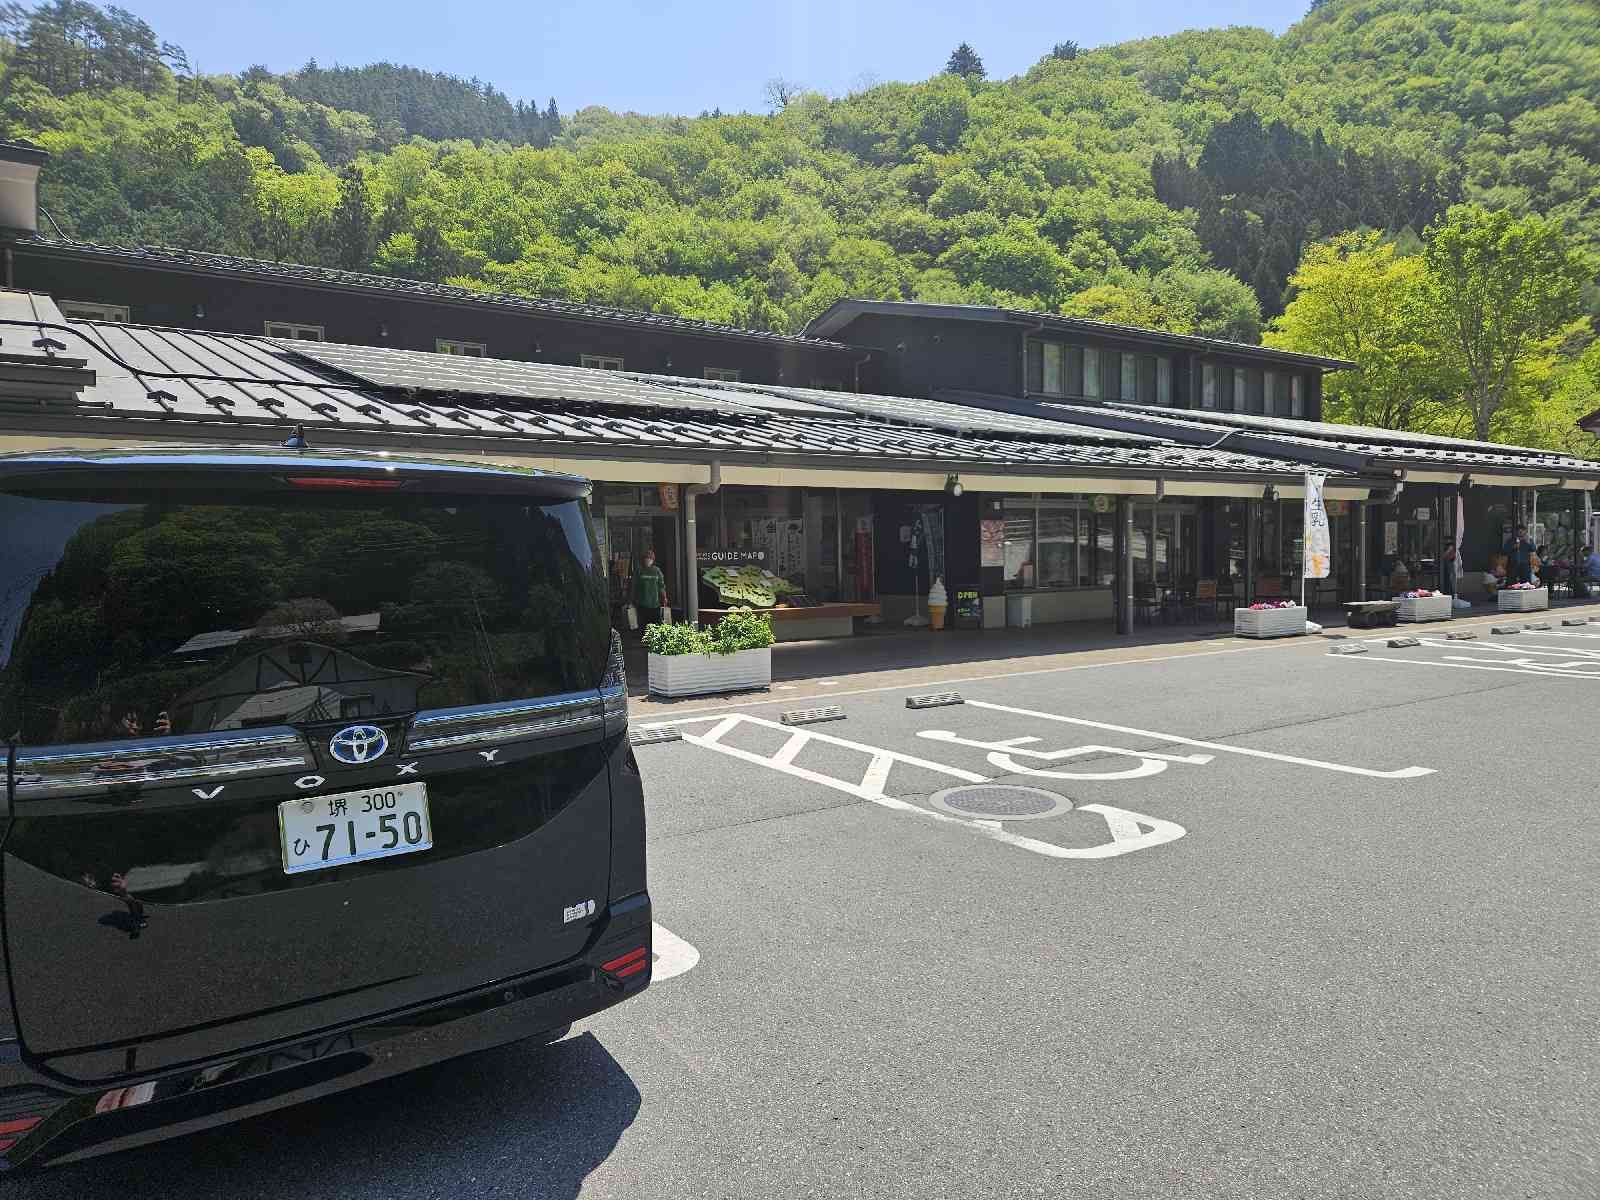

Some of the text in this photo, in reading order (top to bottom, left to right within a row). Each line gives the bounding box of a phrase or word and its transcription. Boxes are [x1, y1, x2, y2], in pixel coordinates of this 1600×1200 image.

[711, 551, 739, 560] GUIDE
[740, 551, 757, 560] MAP
[192, 750, 498, 799] VOXY
[328, 791, 396, 817] 堺 300
[293, 811, 422, 860] ひ 71-50
